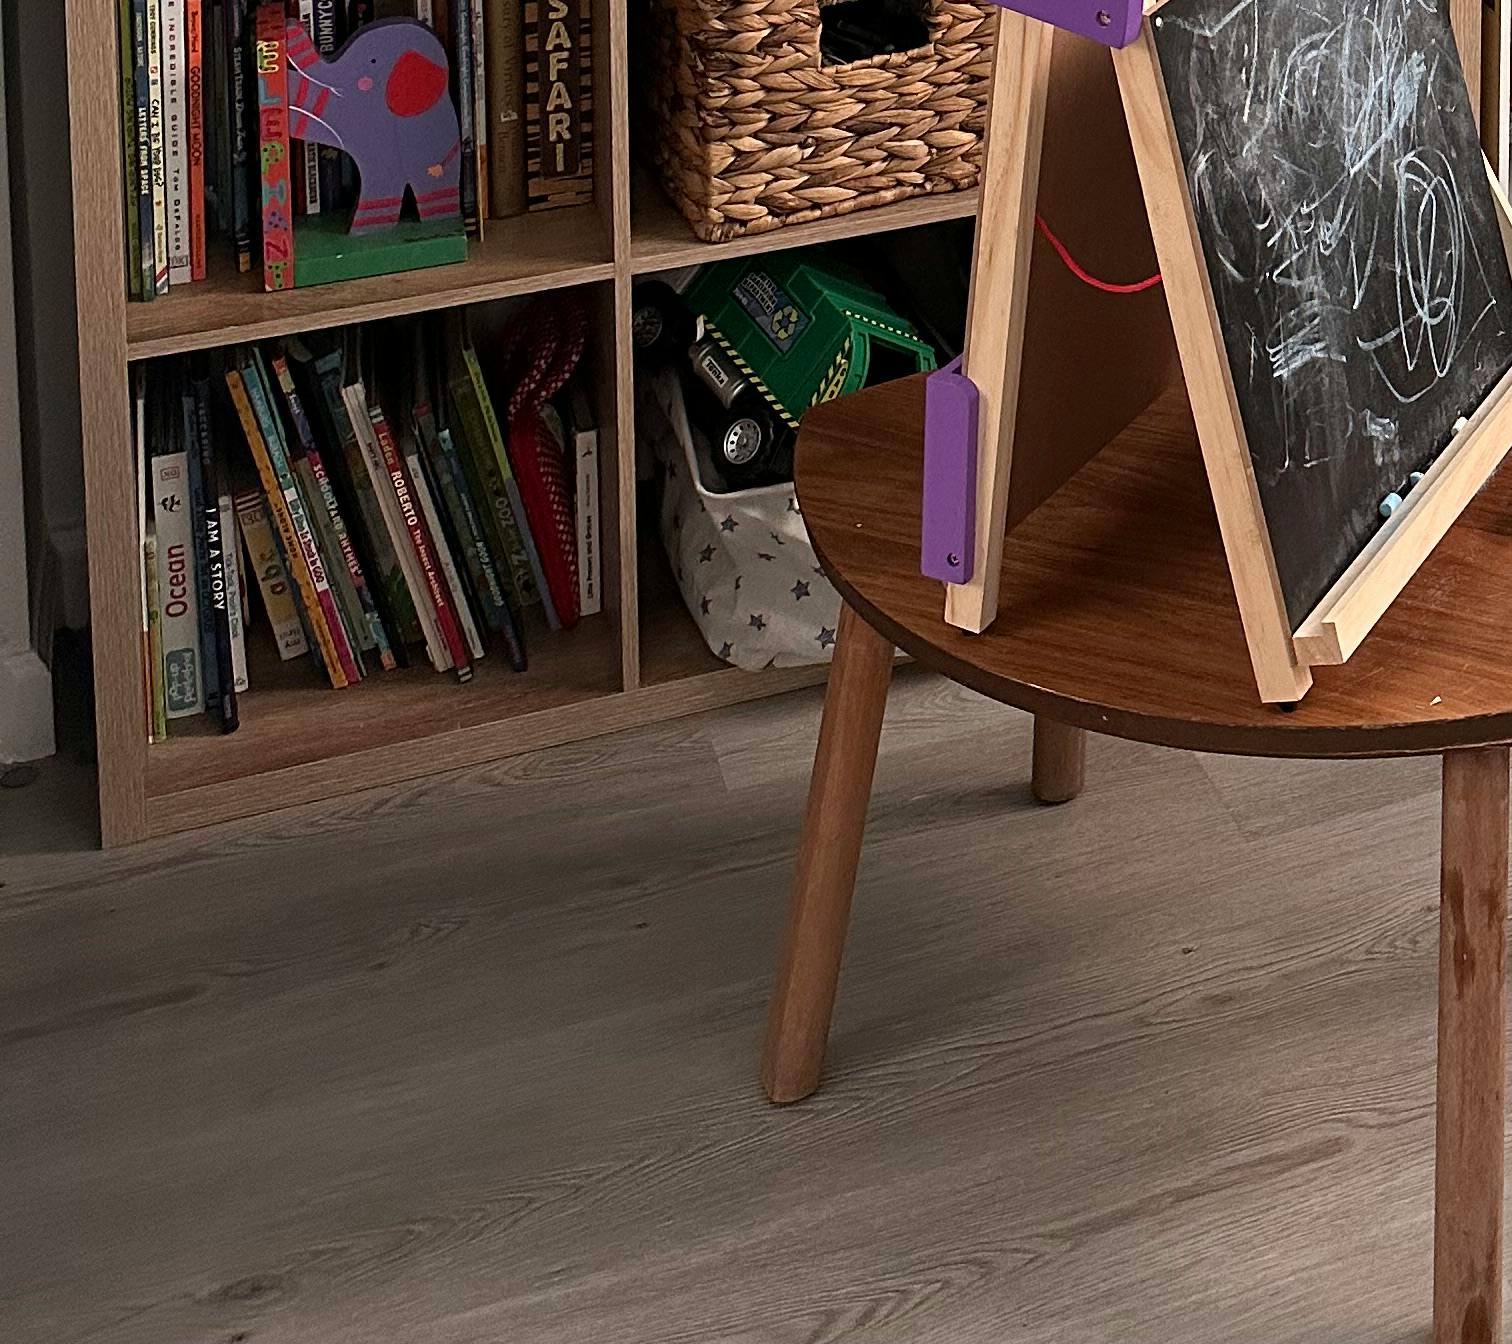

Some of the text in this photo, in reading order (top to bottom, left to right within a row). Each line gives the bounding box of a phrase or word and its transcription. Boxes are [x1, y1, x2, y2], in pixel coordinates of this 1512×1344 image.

[168, 18, 177, 104] INCREDIBLE
[152, 99, 160, 118] CAN
[190, 66, 200, 130] GOODNIGHT
[138, 107, 150, 196] LETTERS FROM SPACE
[191, 131, 201, 166] MOON
[706, 359, 726, 385] Tonka
[206, 520, 219, 543] AM
[312, 463, 362, 577] SCHOOLYARD RHYMES
[378, 433, 444, 607] Laden ROBERTO The Insect Architect
[165, 543, 188, 618] Ocean
[209, 549, 221, 559] A
[210, 563, 225, 611] STORY
